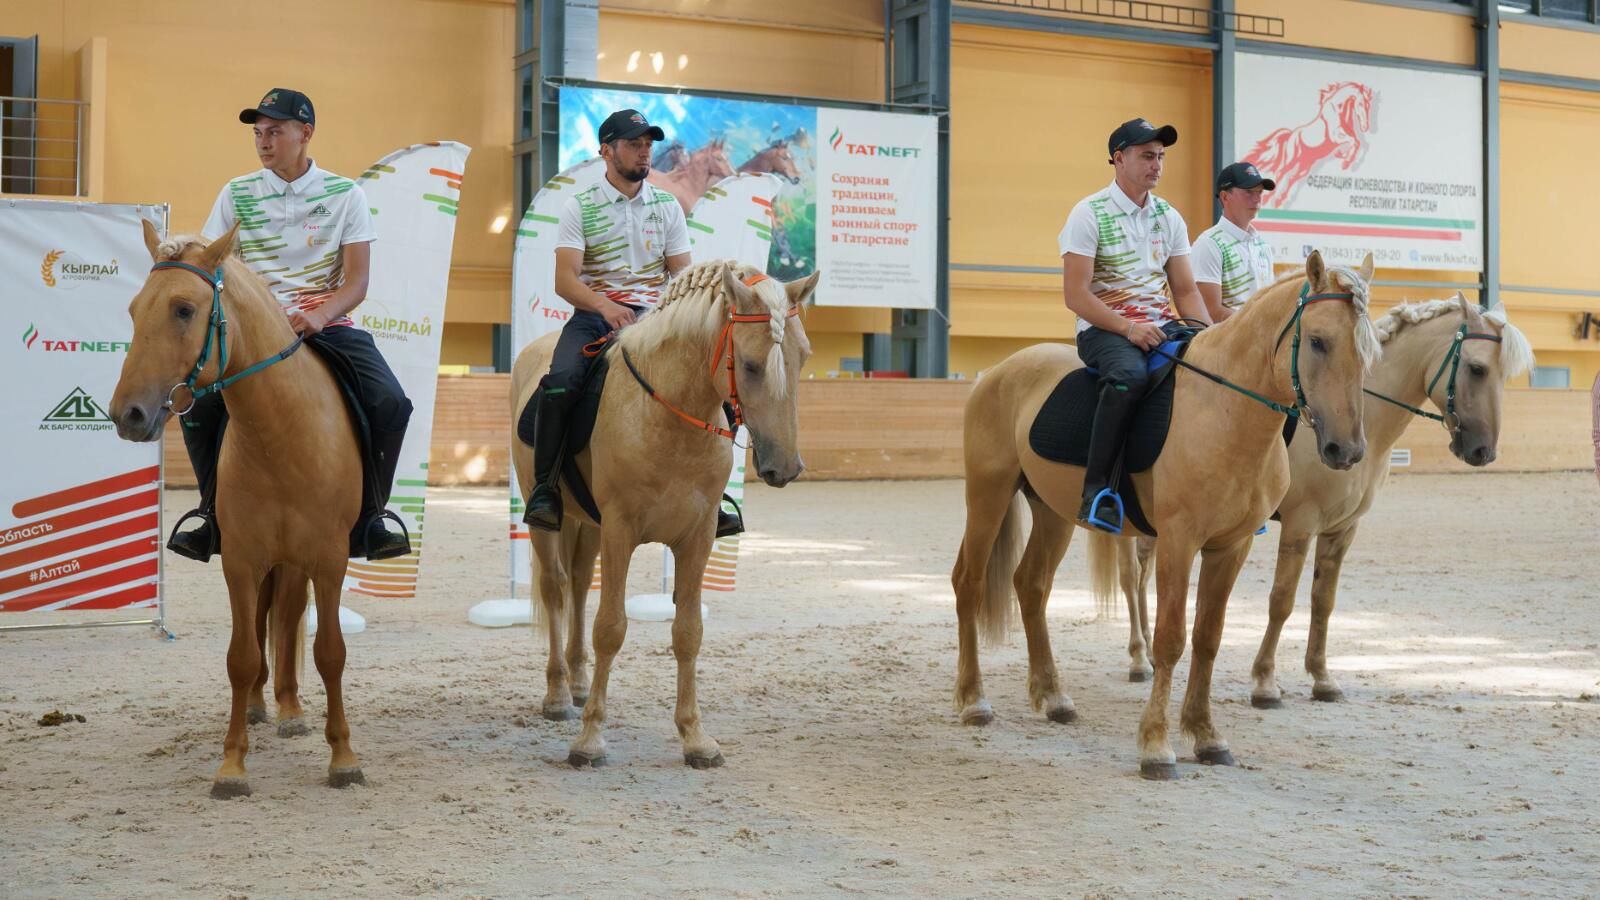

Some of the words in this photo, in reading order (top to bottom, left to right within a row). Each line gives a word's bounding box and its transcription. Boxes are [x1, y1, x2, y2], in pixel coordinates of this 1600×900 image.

[846, 143, 921, 158] TATNEFT
[832, 172, 889, 187] Сохраняя
[1307, 175, 1352, 192] ФЕДЕРАЦИЯ
[1354, 178, 1406, 194] КОНЕВОДСТВА
[1408, 181, 1414, 193] И
[1416, 182, 1448, 196] КОННОГО
[1449, 184, 1477, 197] СПОРТА
[832, 189, 898, 202] традиции,
[832, 204, 897, 216] развиваем
[1349, 195, 1397, 210] РЕСПУБЛИКИ
[1399, 199, 1438, 212] ТАТАРСТАН
[832, 219, 881, 230] конный
[883, 222, 918, 233] спорт
[832, 234, 838, 242] в
[841, 233, 909, 247] Татарстане
[62, 259, 119, 275] КЫРЛАЙ
[362, 314, 432, 337] КЫРЛАЙ
[42, 340, 133, 352] TATNEFT
[39, 423, 49, 431] АК
[51, 423, 74, 431] БАРС
[75, 423, 113, 431] ХОЛДИНГ
[29, 559, 81, 583] #Алтай
